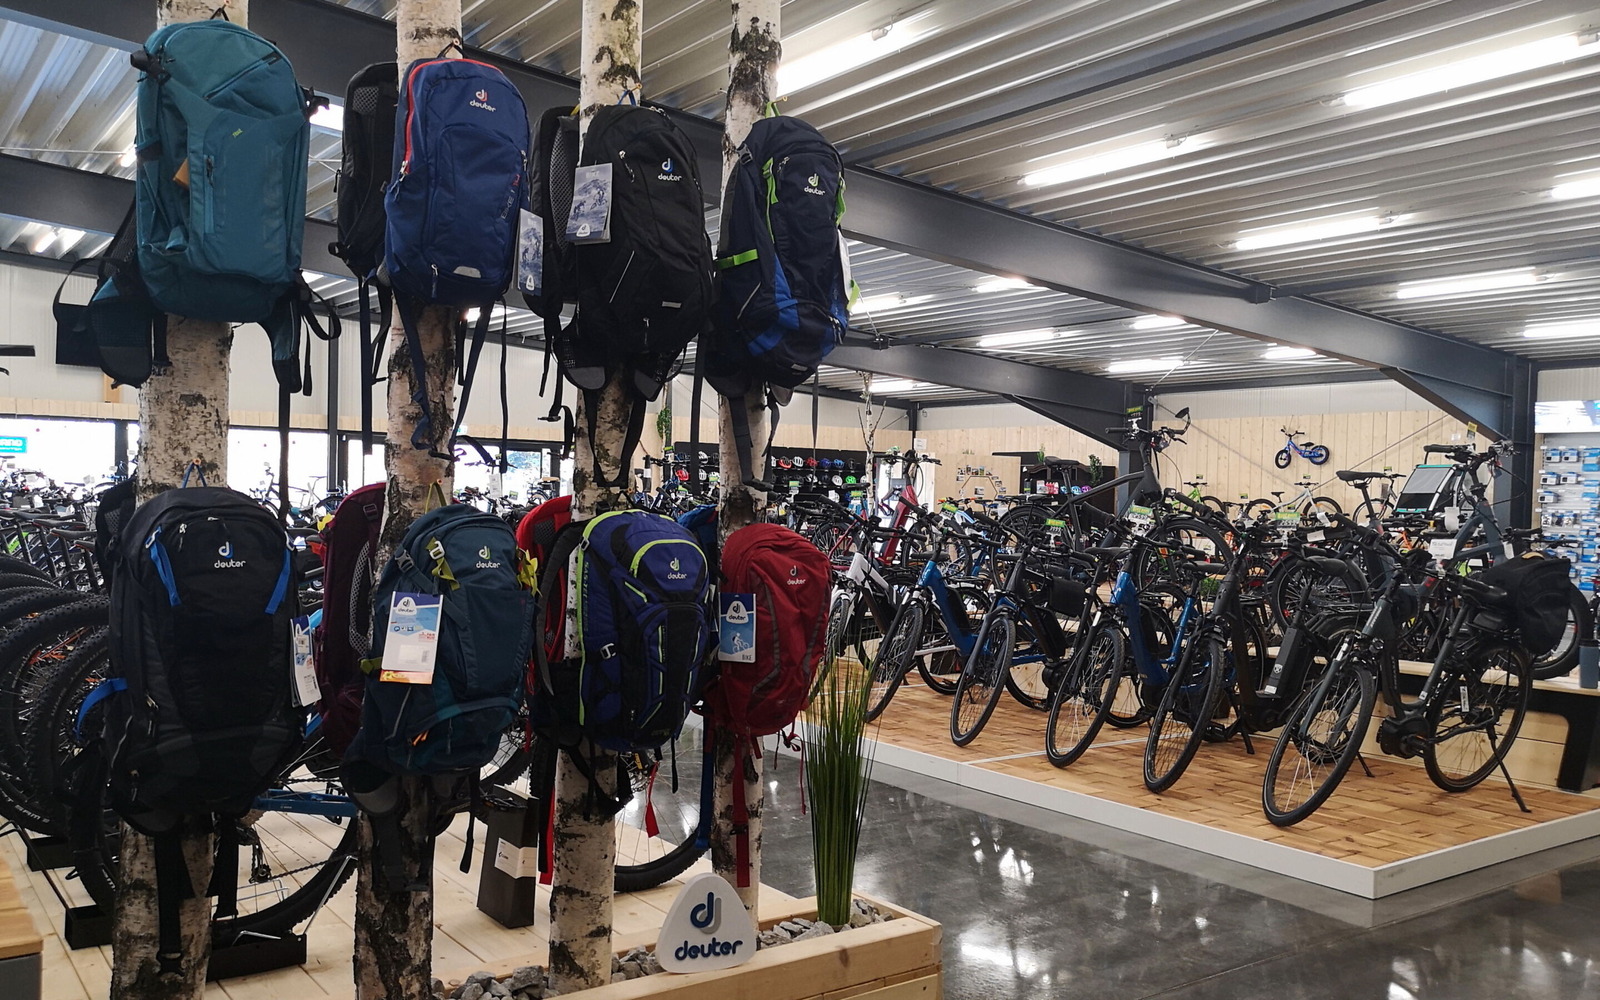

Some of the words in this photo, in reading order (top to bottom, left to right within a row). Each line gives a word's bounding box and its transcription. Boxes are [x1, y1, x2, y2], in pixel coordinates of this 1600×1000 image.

[469, 100, 496, 112] deuter
[657, 173, 682, 181] deuter
[804, 186, 826, 195] deuter
[214, 559, 246, 568] deuter
[475, 560, 500, 568] deuter
[674, 937, 744, 961] deuter
